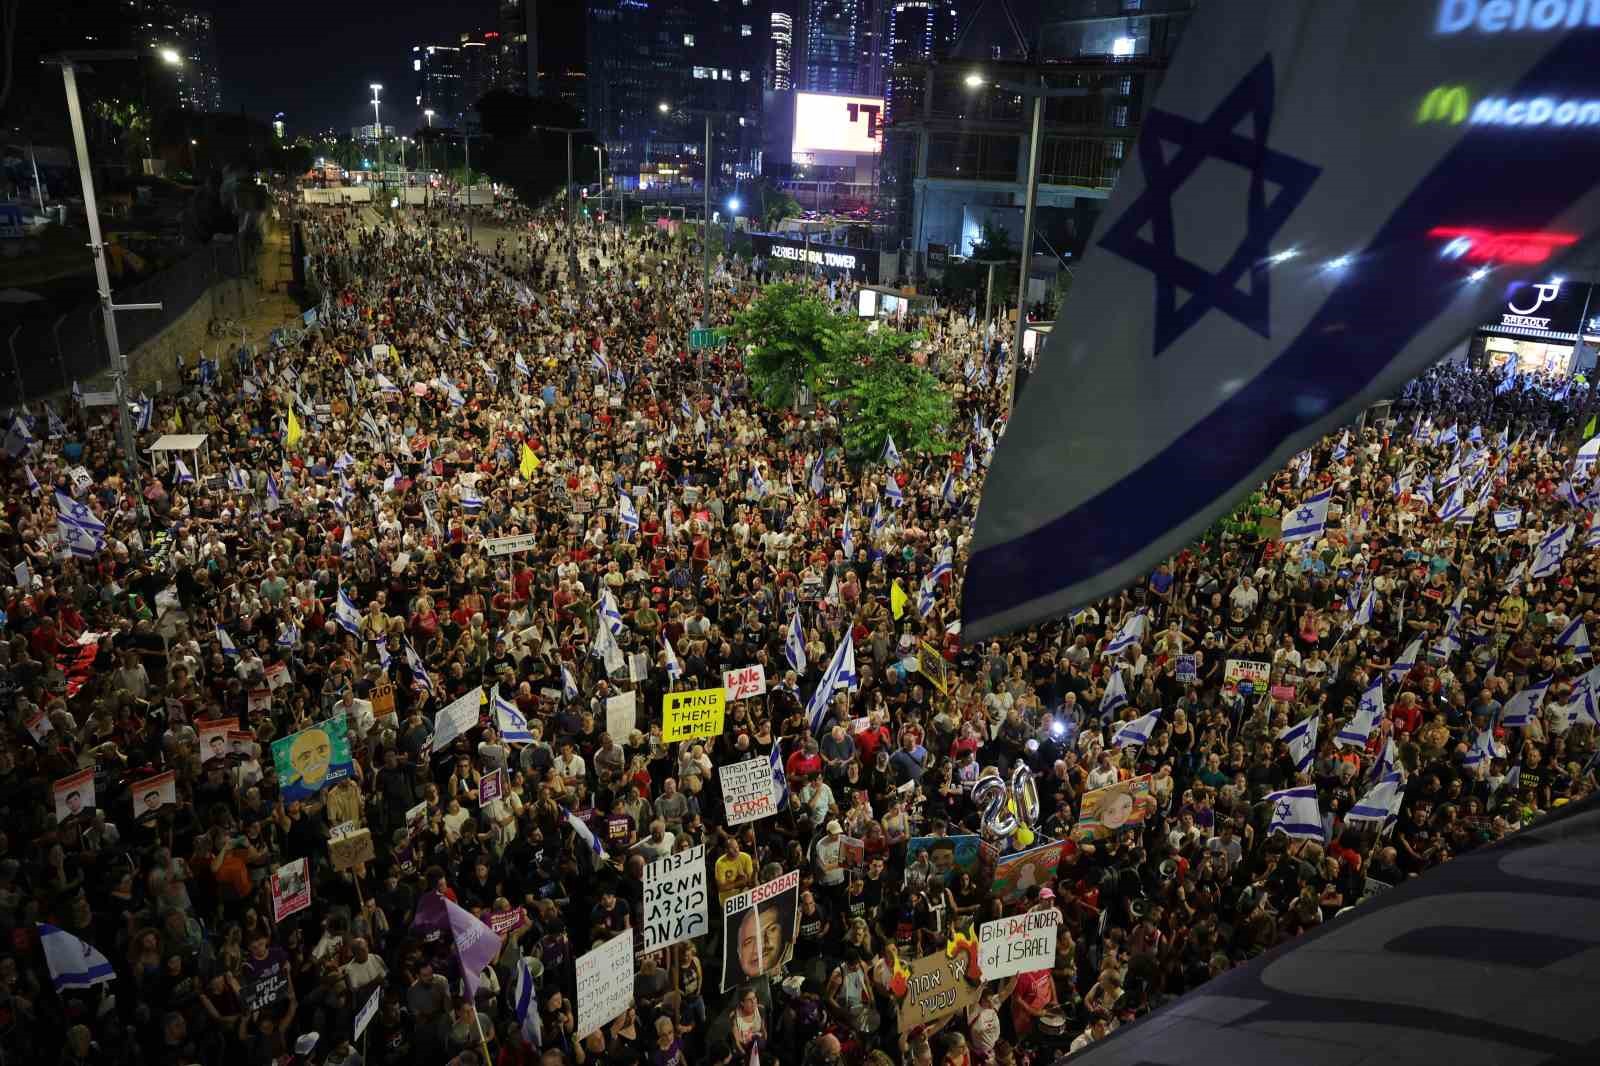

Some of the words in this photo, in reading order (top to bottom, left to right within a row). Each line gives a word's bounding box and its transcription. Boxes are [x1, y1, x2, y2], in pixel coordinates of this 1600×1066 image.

[771, 245, 799, 260] AZRIELI
[824, 252, 856, 269] TOWER
[672, 694, 717, 710] BRING
[672, 720, 717, 736] HOME!
[644, 872, 702, 903] ממשלה
[726, 894, 748, 914] BIBI
[752, 872, 798, 904] ESCOBAR
[647, 891, 704, 921] בוגדת
[644, 913, 703, 948] בעמה
[982, 920, 1006, 943] Bibi
[988, 943, 1000, 969] of
[1006, 937, 1051, 963] ISRAEL
[920, 986, 956, 1017] עכשיו
